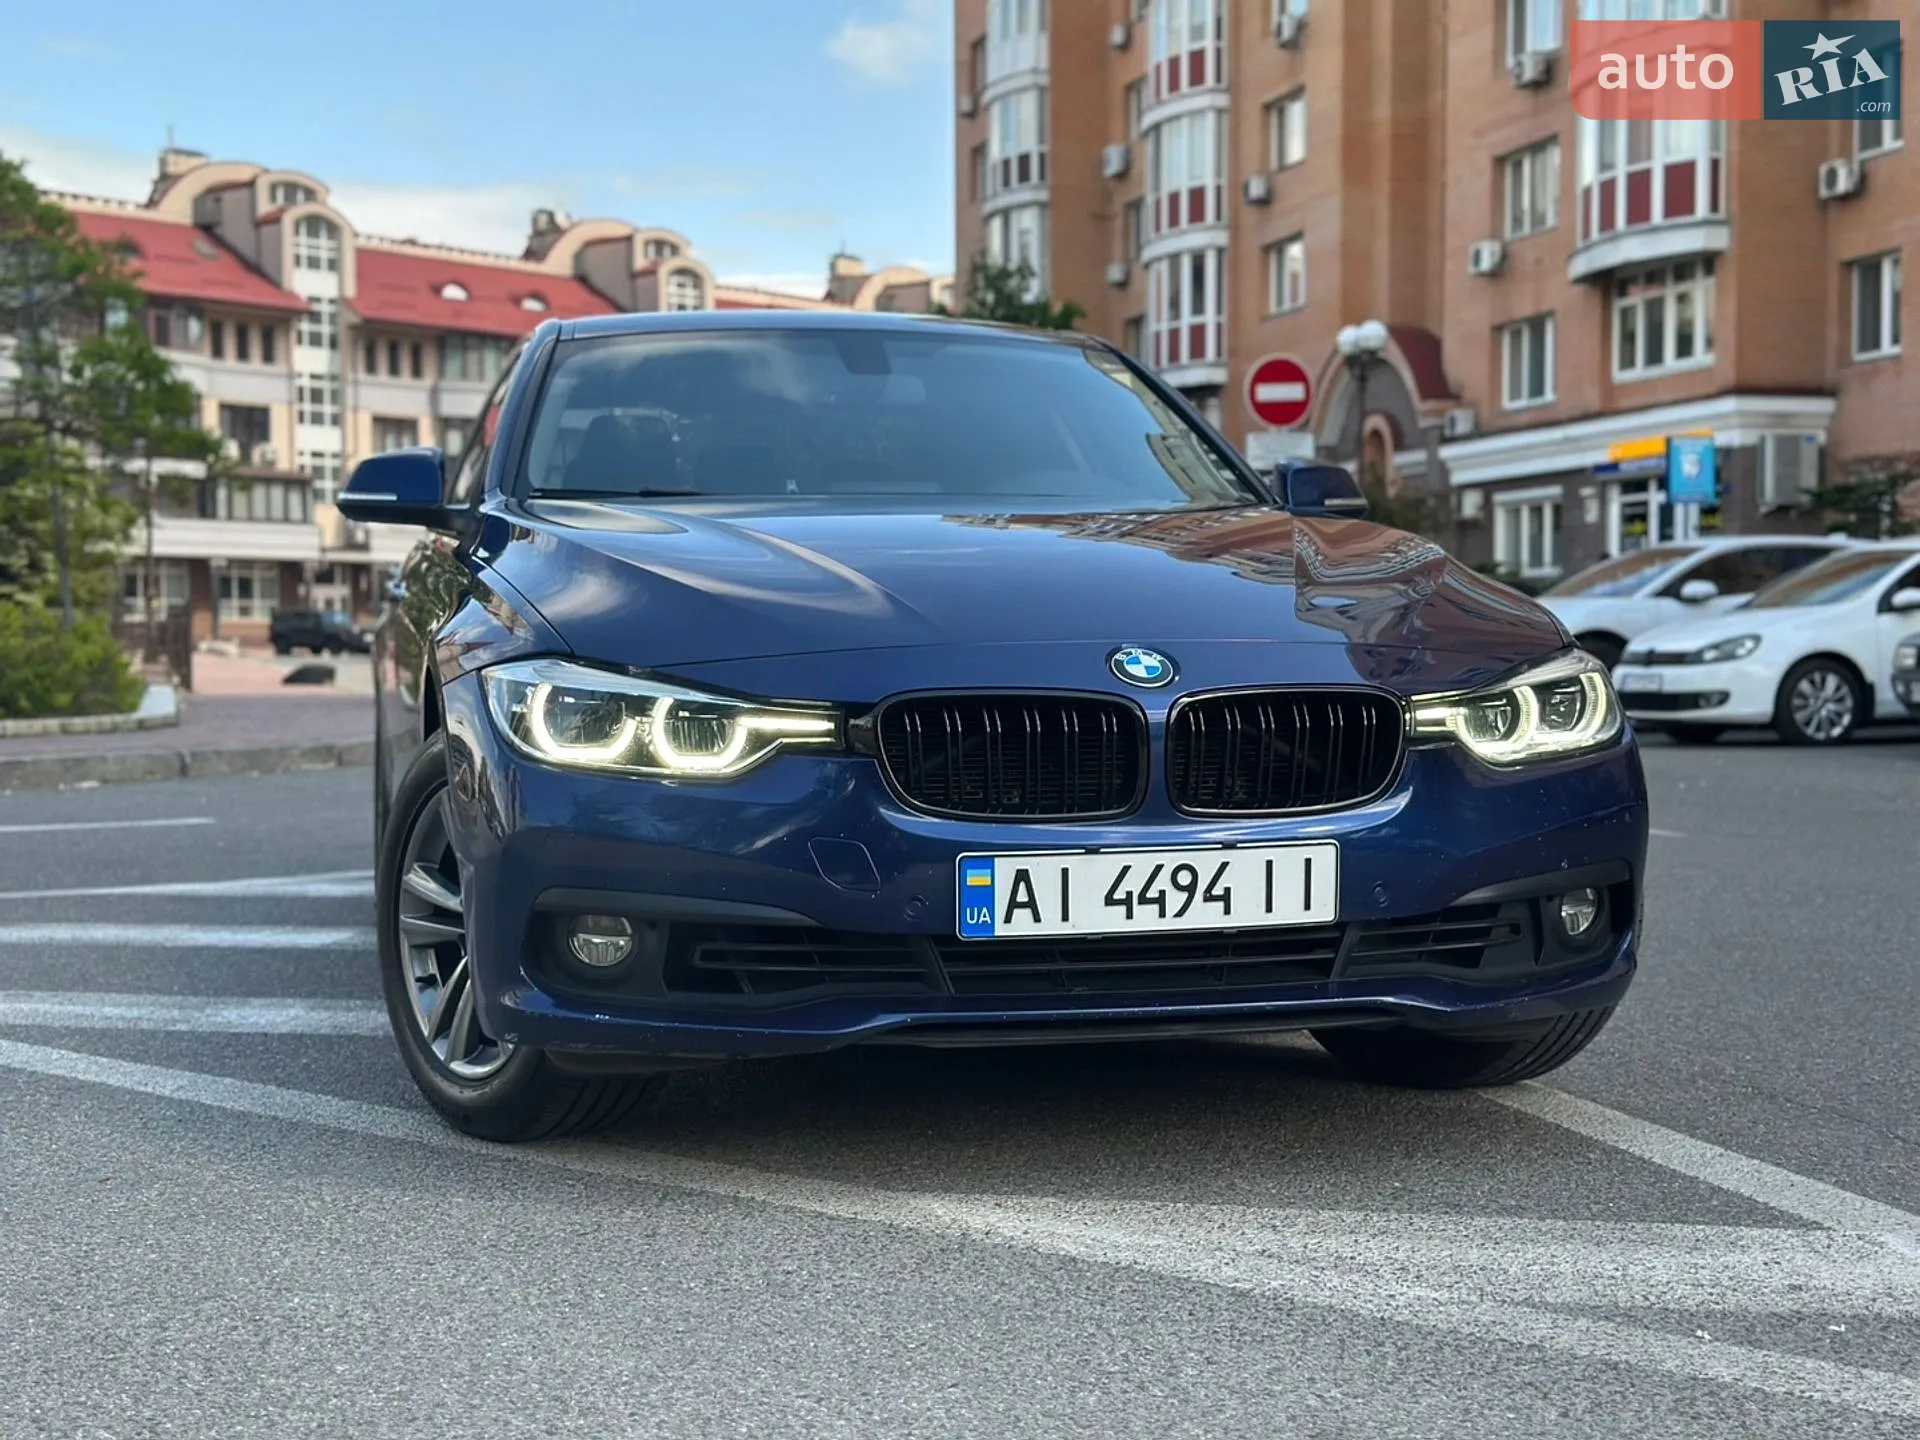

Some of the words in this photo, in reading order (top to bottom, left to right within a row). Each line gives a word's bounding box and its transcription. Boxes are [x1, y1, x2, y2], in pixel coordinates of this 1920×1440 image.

[1003, 866, 1070, 924] AI
[1104, 861, 1232, 920] 4494
[1265, 857, 1312, 914] II
[966, 907, 992, 925] UA
